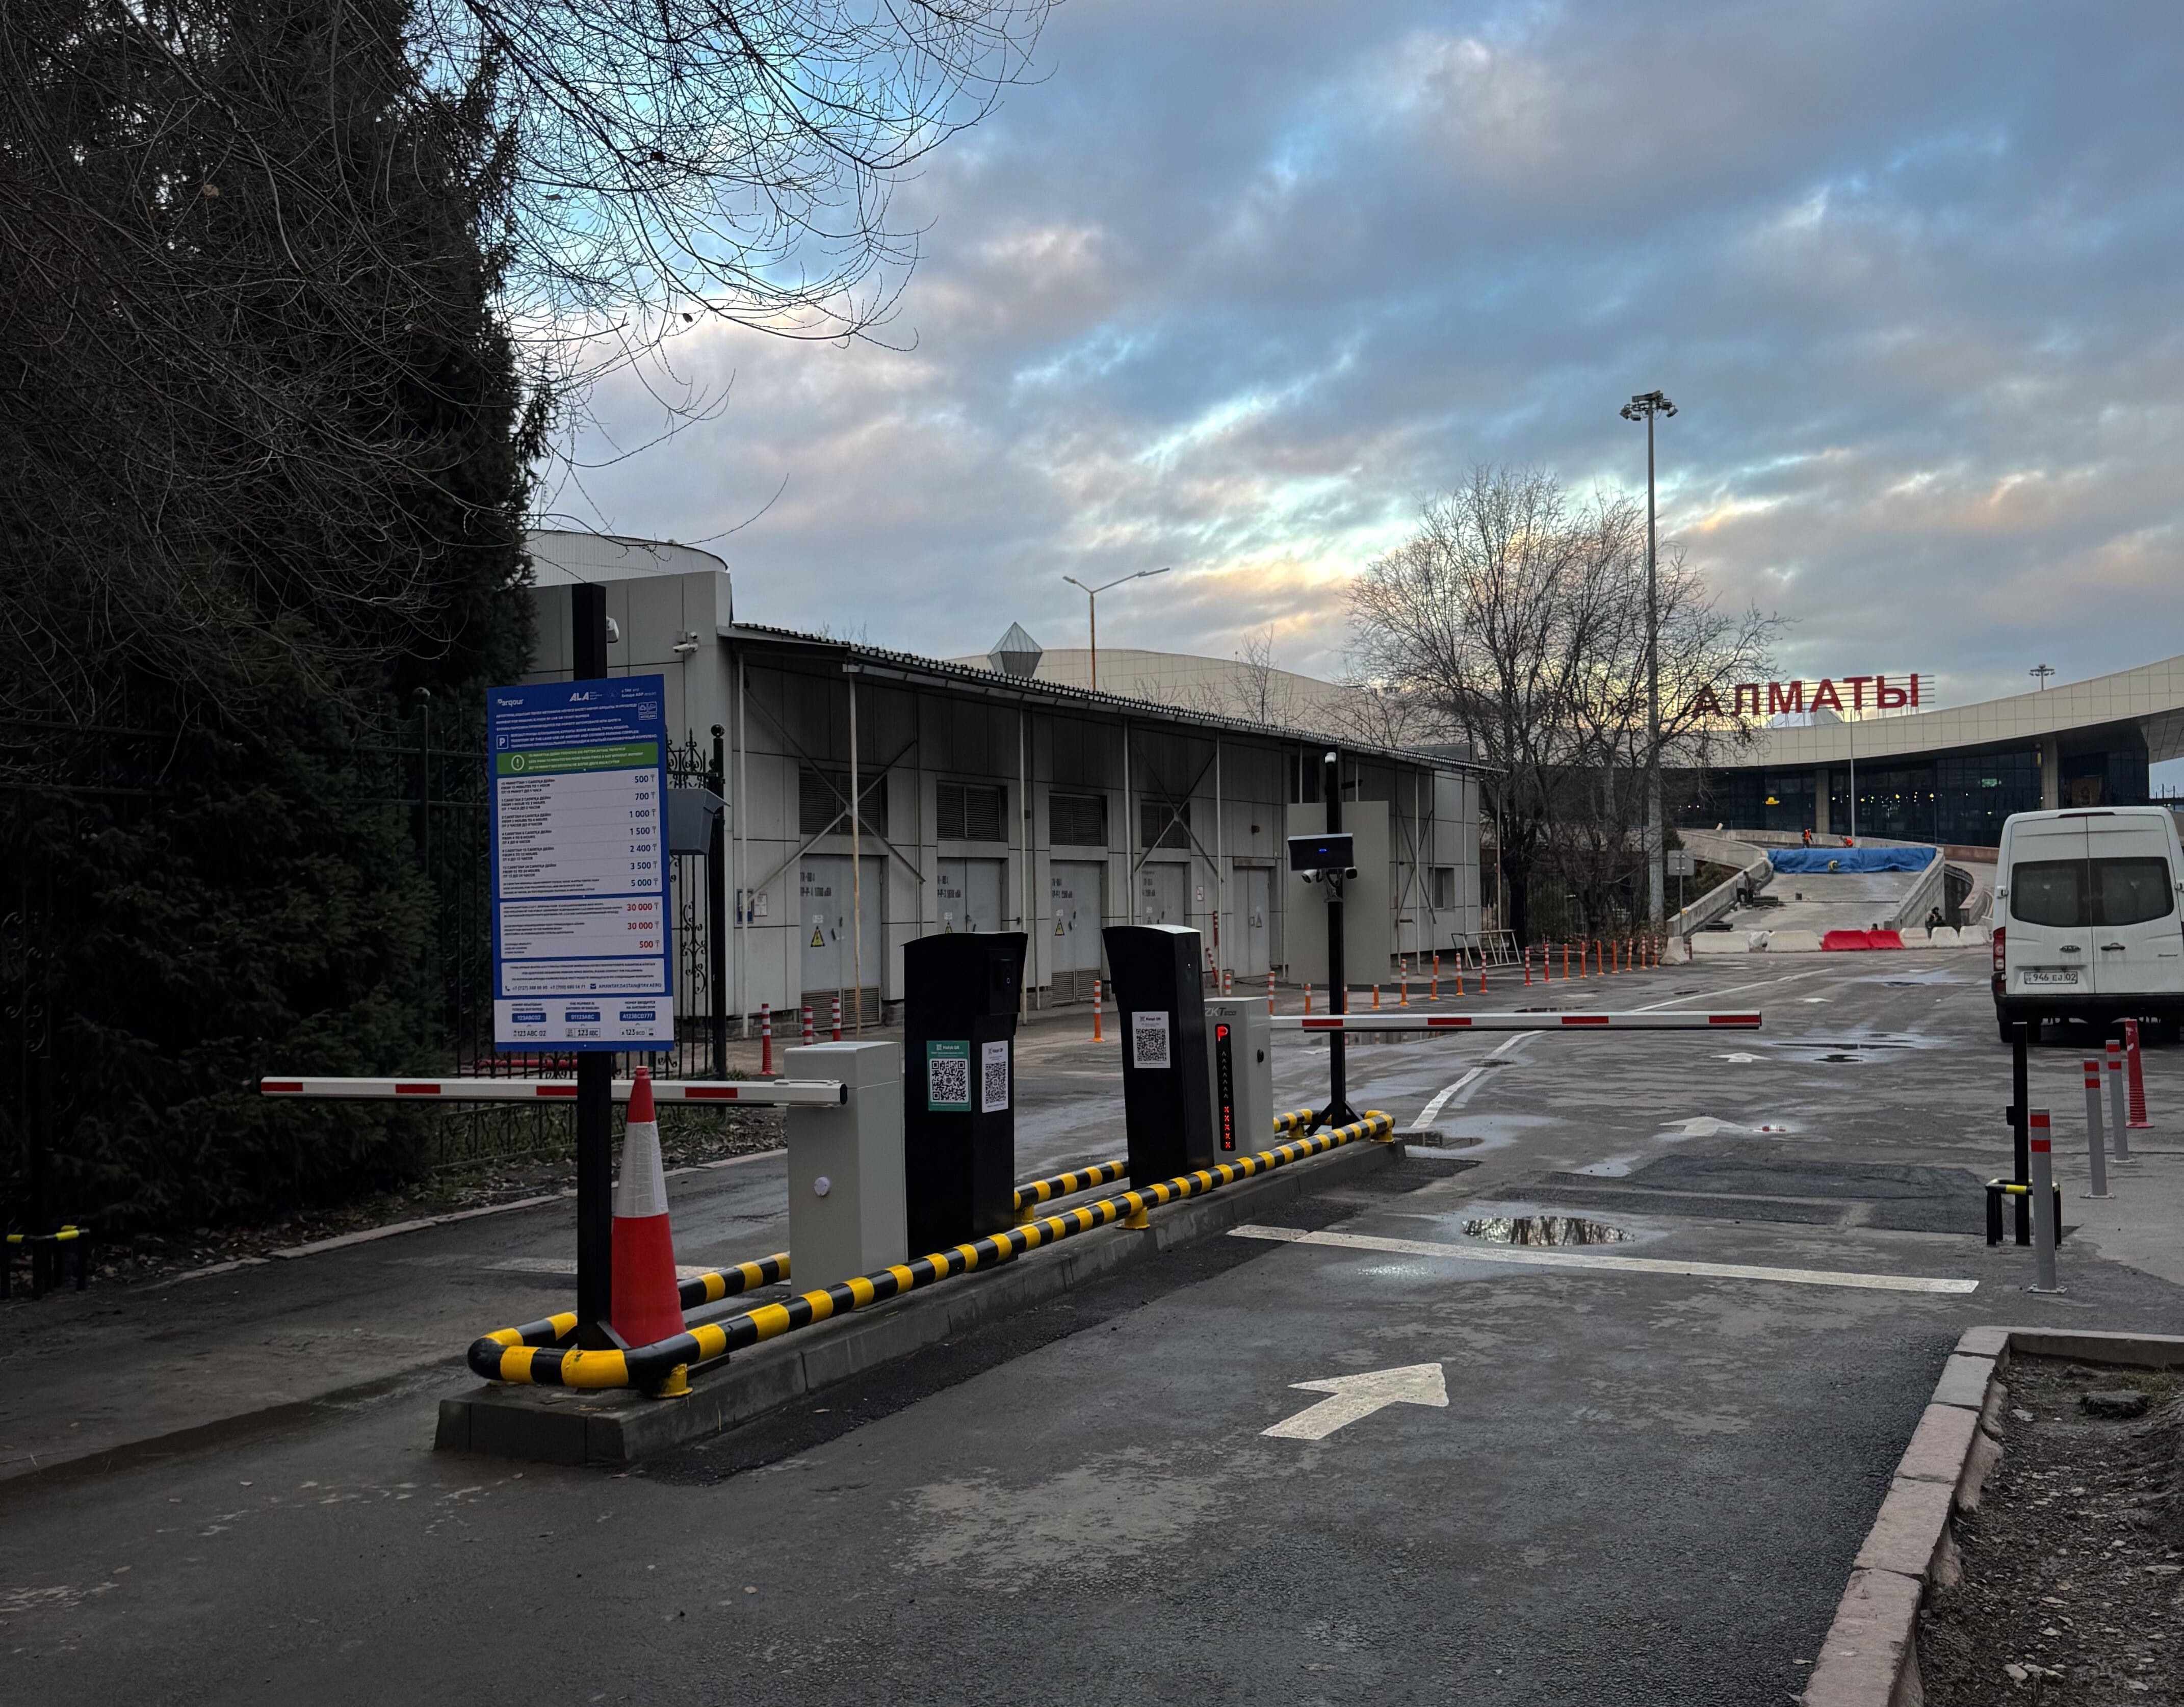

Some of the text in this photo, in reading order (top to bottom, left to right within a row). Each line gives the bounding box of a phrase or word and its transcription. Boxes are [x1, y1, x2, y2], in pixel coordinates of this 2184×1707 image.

[569, 692, 589, 701] ALA
[1691, 673, 1918, 717] АЛМАТЫ
[498, 697, 524, 708] Parqour
[499, 737, 505, 746] P
[634, 775, 648, 783] 500
[635, 792, 648, 800] 700
[635, 809, 649, 818] 000
[1217, 1026, 1228, 1042] P
